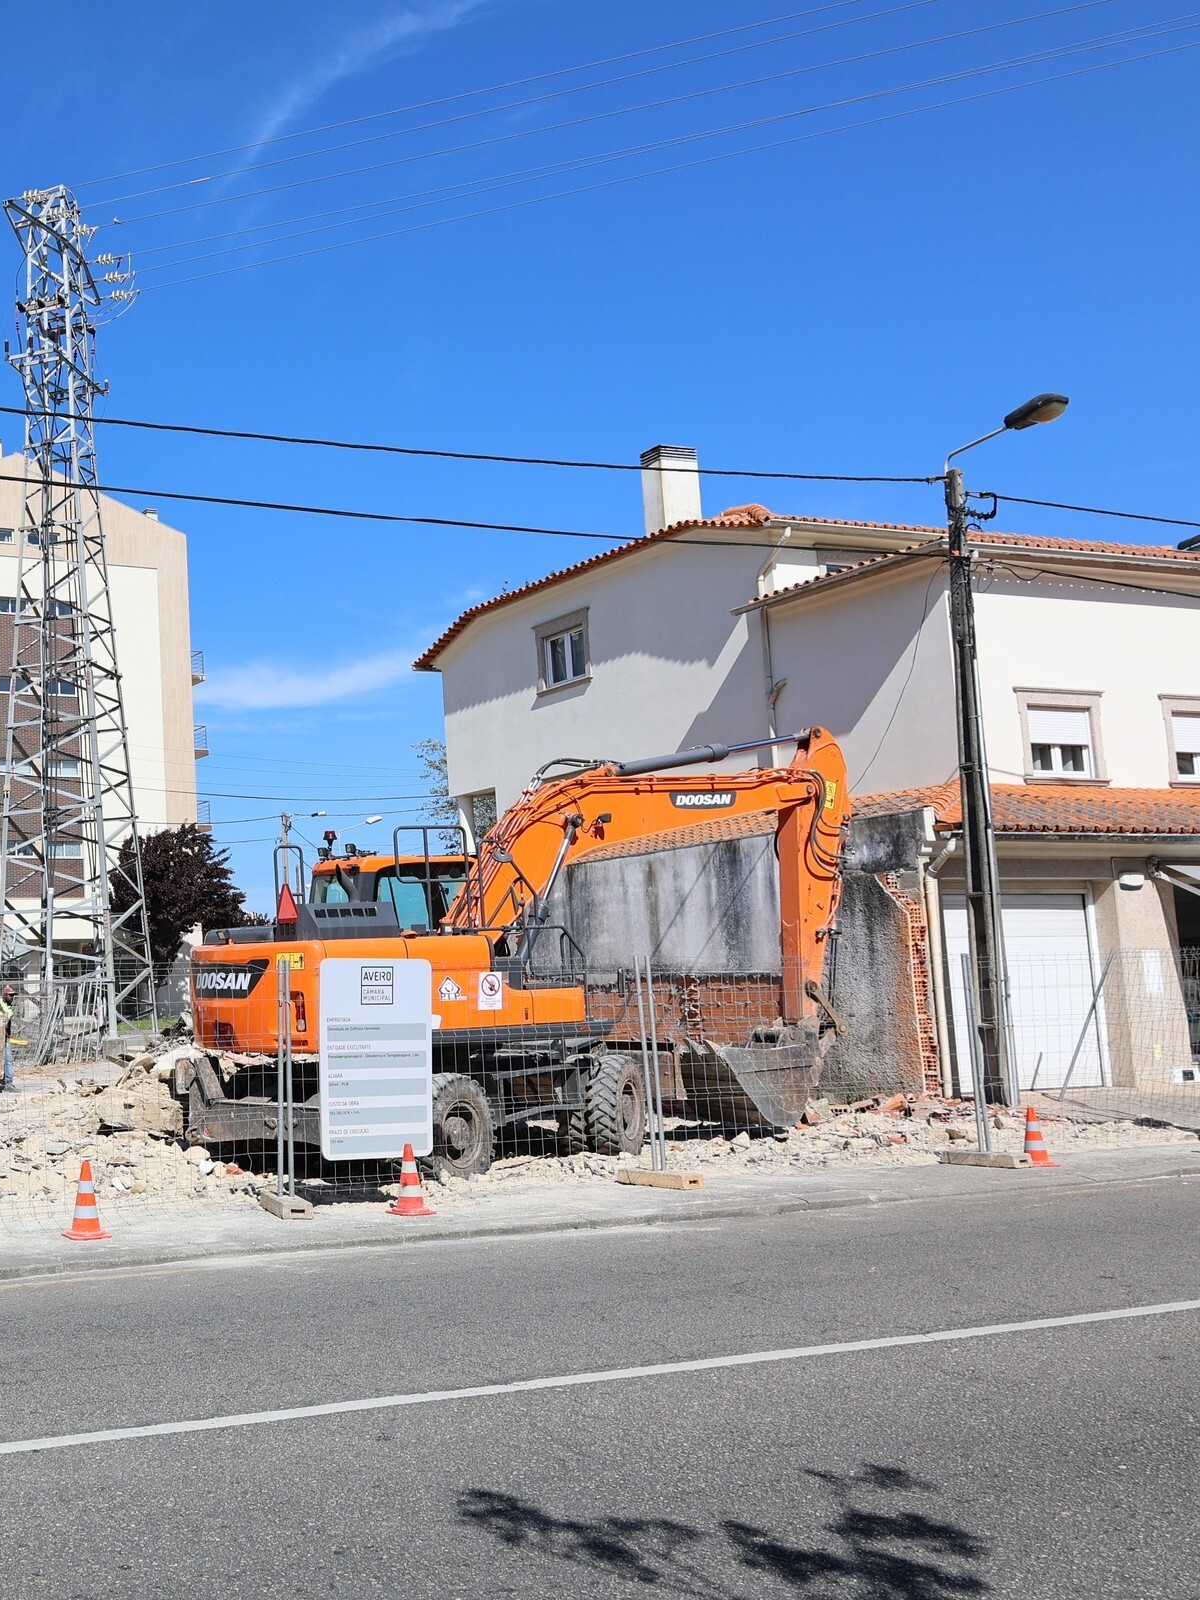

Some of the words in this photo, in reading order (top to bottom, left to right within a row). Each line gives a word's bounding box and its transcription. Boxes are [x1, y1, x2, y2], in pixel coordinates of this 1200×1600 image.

[675, 794, 732, 806] DOOSAN
[196, 972, 251, 990] DOOSAN
[363, 971, 392, 981] AVEIRO
